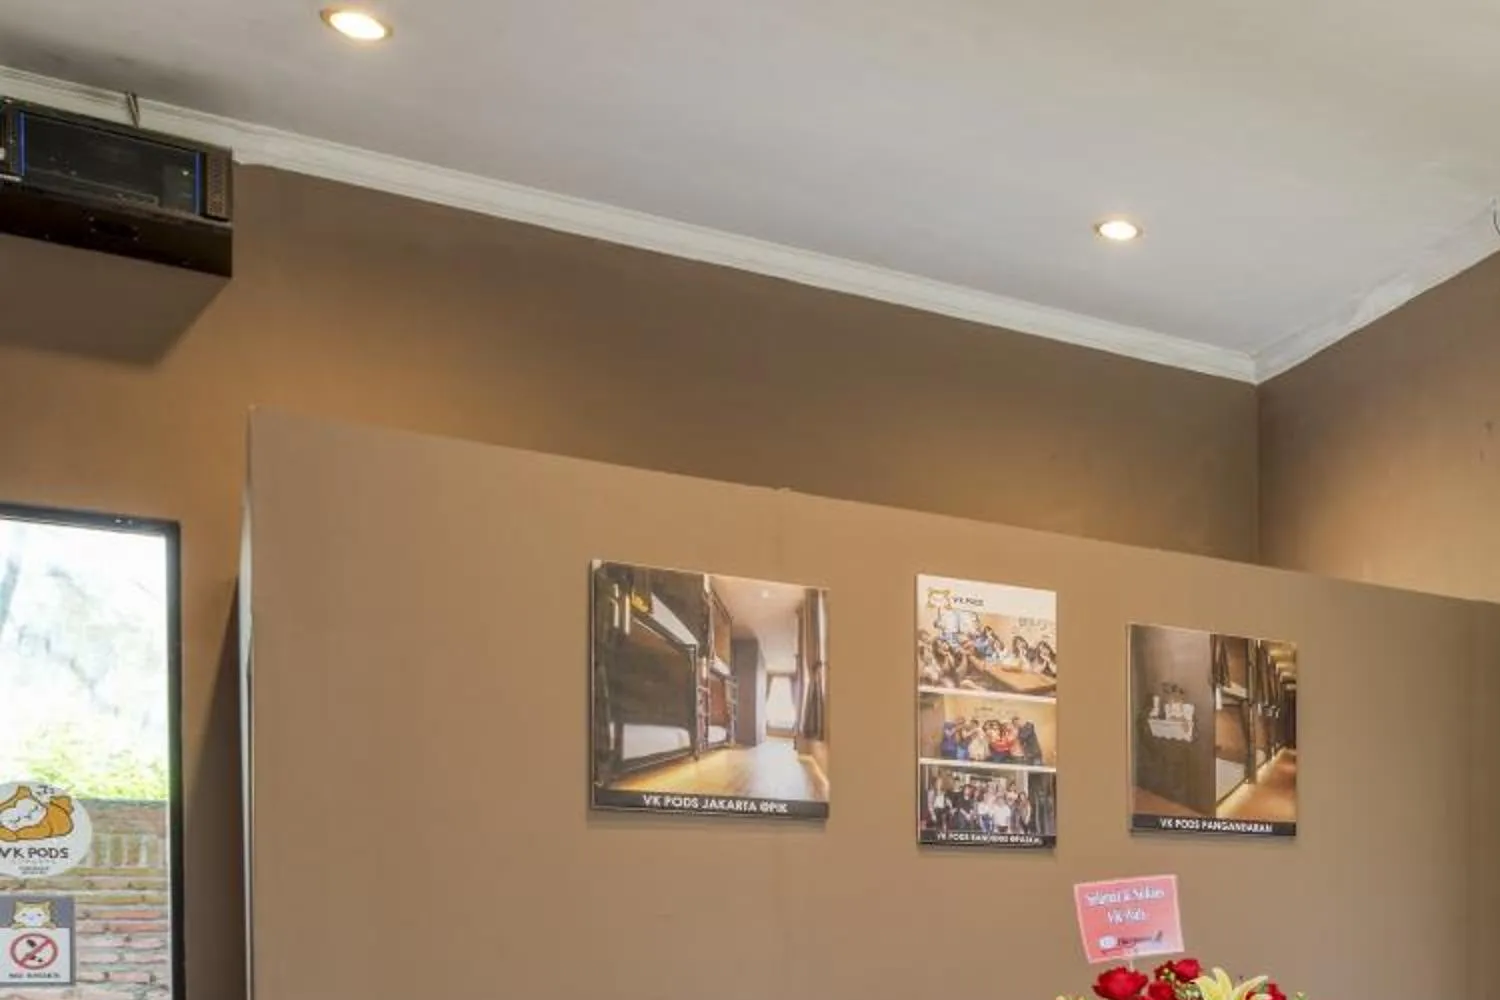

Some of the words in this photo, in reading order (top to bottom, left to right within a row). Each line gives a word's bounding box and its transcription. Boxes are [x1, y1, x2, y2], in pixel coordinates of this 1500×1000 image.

[642, 795, 661, 807] VK
[664, 796, 700, 809] PODS
[702, 798, 758, 813] JAKARTA
[1160, 818, 1174, 829] VK
[1175, 819, 1200, 830] PODS
[0, 847, 25, 859] VK
[28, 847, 69, 859] PODS
